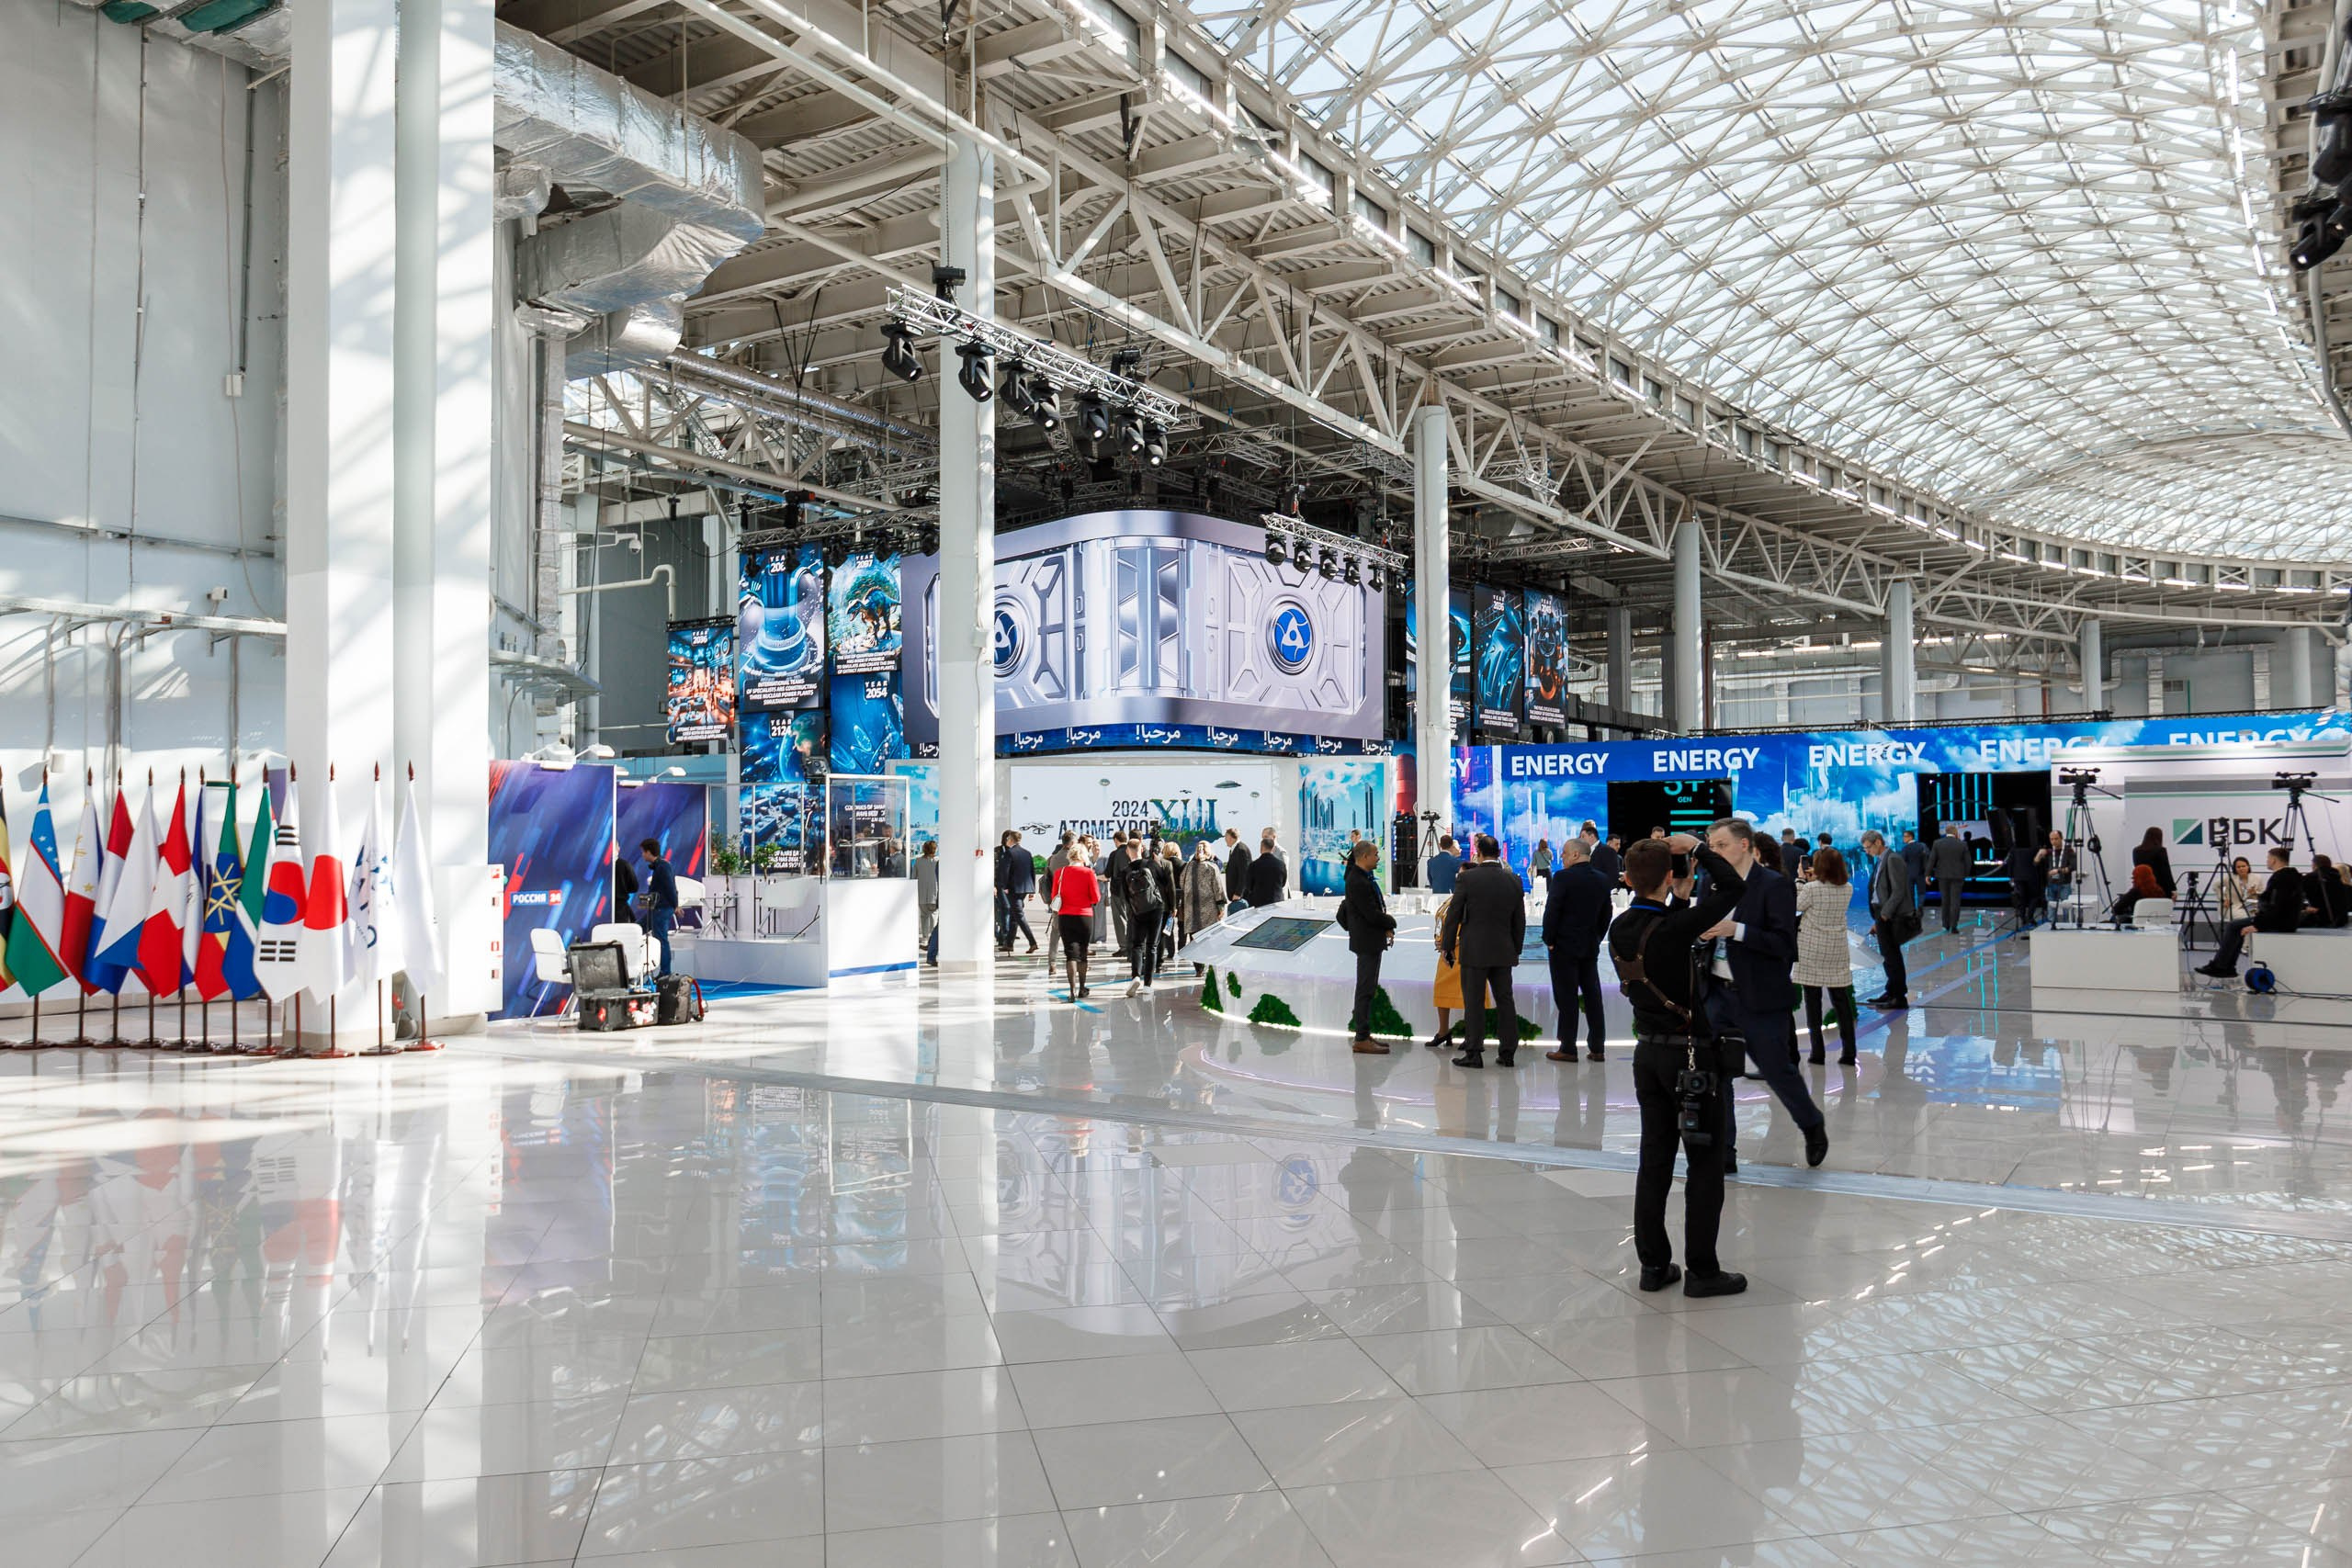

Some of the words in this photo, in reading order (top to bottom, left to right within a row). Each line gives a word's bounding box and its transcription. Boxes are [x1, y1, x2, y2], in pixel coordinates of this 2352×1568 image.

[865, 688, 888, 698] 2054
[771, 726, 791, 737] 2124
[1067, 728, 1102, 745] مرحبا!
[1136, 724, 1181, 743] مرحبا!
[1207, 726, 1238, 746] مرحبا!
[1014, 732, 1044, 749] مرحبا!
[1263, 731, 1292, 750] مرحبا!
[1316, 735, 1342, 753] مرحبا!
[919, 742, 939, 757] رحبا!
[1808, 741, 1927, 767] ENERGY
[1511, 753, 1609, 777] ENERGY
[1654, 748, 1760, 773] ENERGY
[1113, 801, 1148, 817] 2024
[513, 893, 547, 903] РОССИЯ
[550, 892, 561, 903] 24
